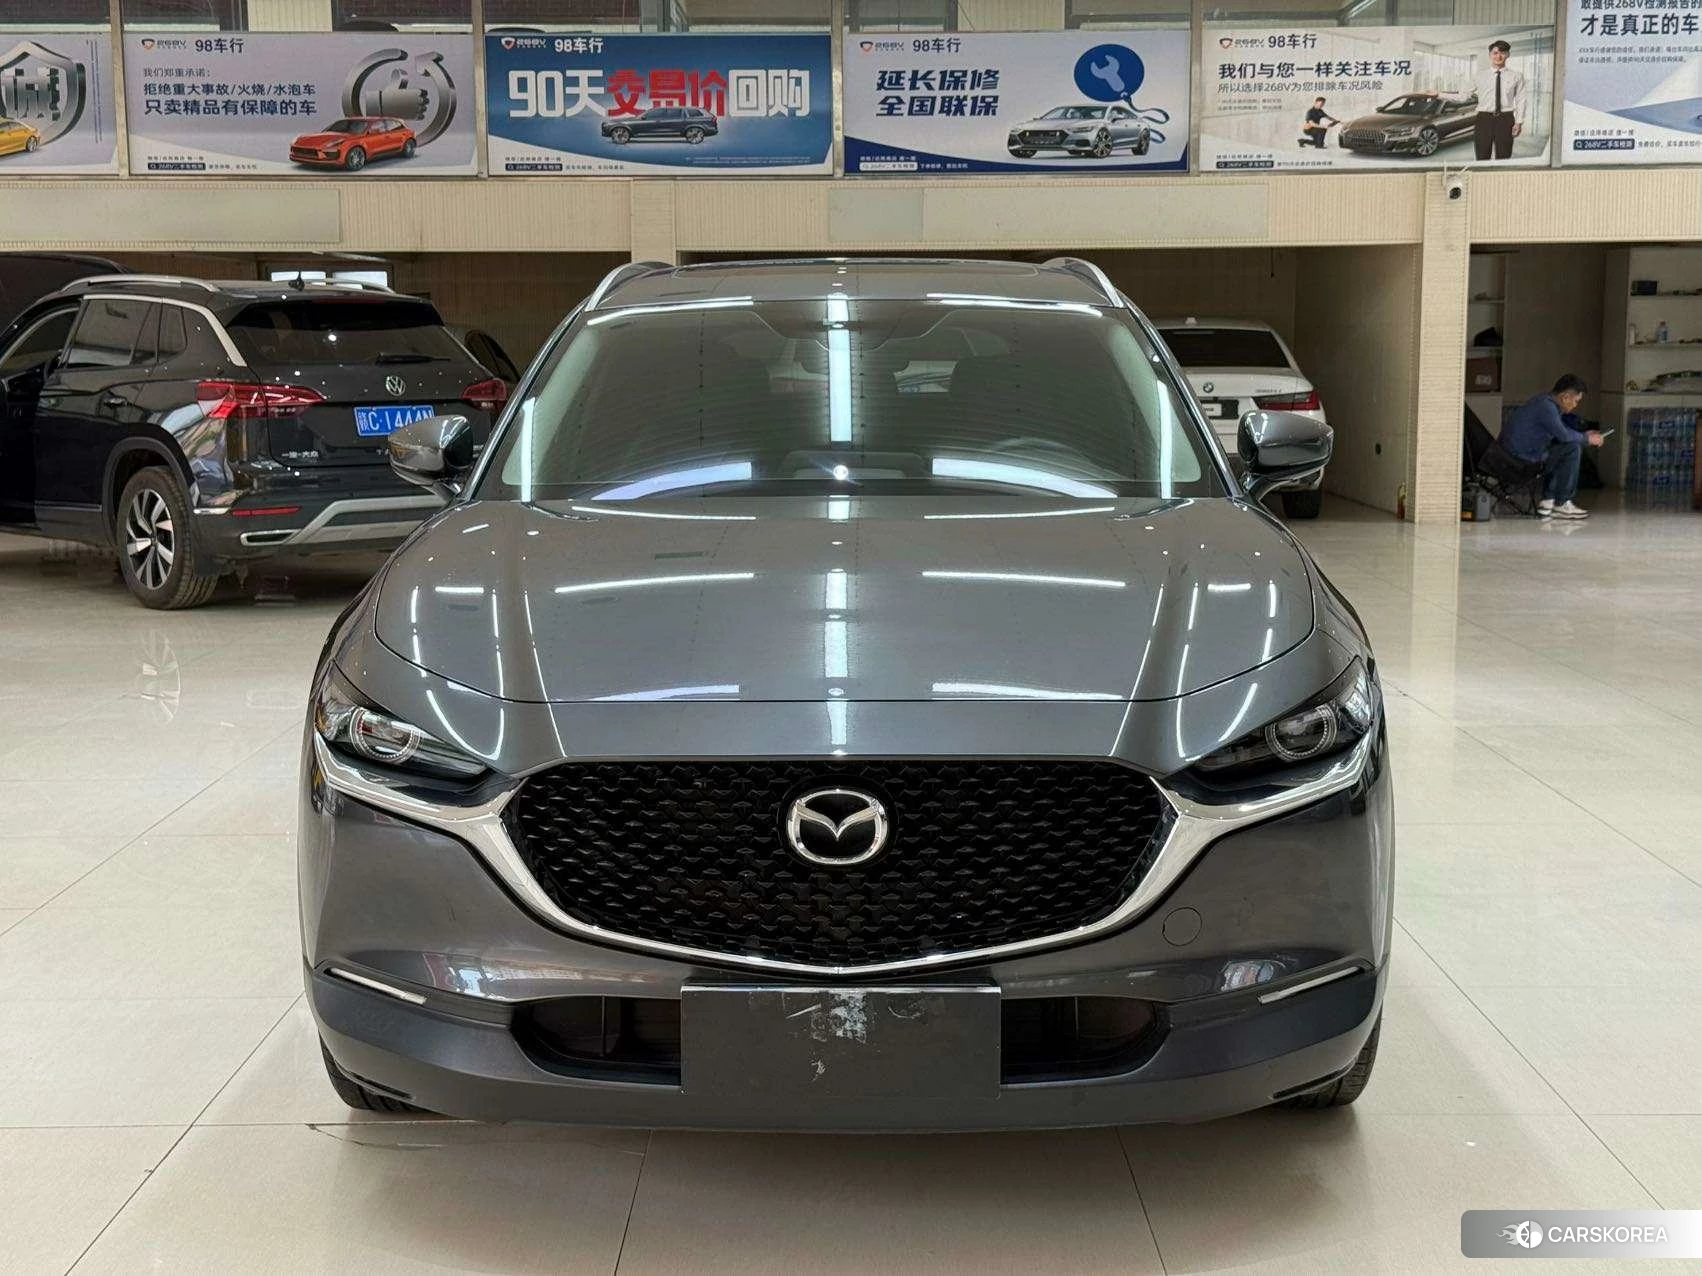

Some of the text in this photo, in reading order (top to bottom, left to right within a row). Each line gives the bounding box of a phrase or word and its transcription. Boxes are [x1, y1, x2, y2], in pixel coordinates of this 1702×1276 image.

[1580, 13, 1700, 36] 才是真正的车
[195, 38, 245, 54] 98车行
[554, 37, 604, 54] 98车行
[912, 37, 961, 53] 98车行
[1268, 33, 1318, 49] 98车行
[1218, 60, 1412, 80] 我们与您一样关注车况
[876, 69, 1000, 91] 延长保修
[1217, 80, 1384, 94] 所以选择268V为您排除车况风险
[143, 82, 317, 96] 拒绝重大事故/火烧/水泡车
[508, 68, 811, 118] 90天交易价回购
[144, 99, 318, 117] 只卖精品有保障的车
[876, 94, 1000, 117] 全国联保
